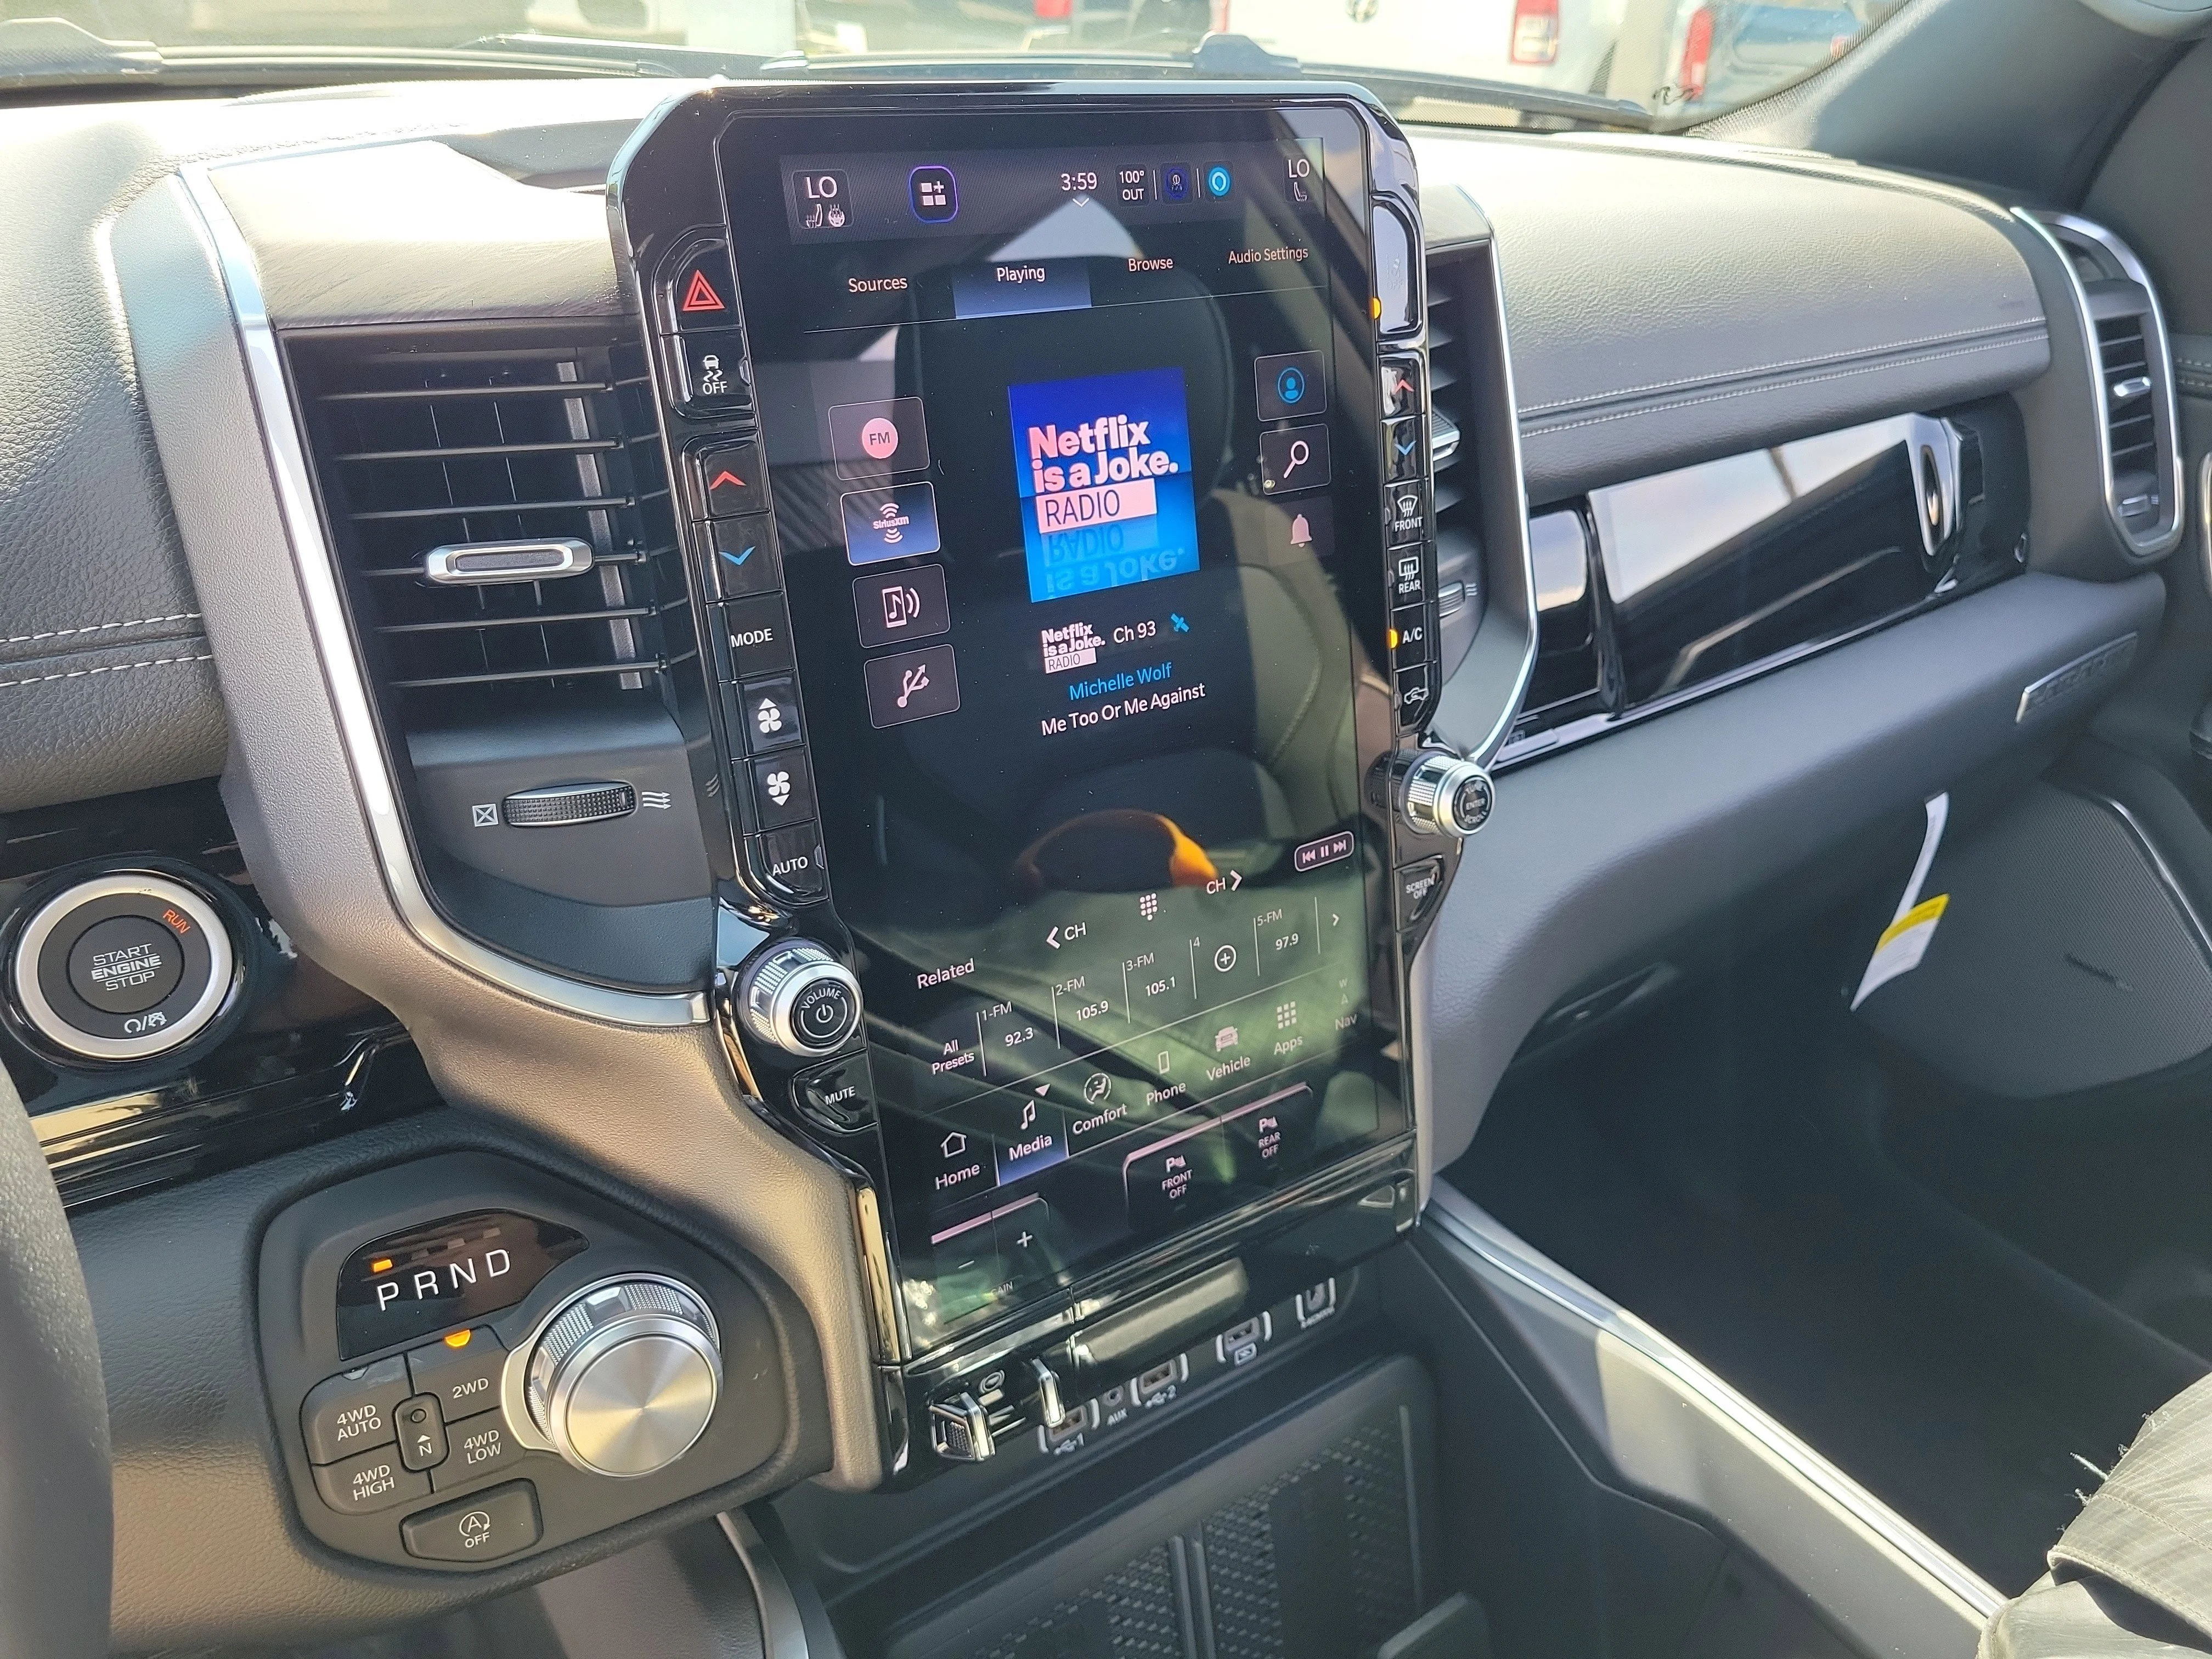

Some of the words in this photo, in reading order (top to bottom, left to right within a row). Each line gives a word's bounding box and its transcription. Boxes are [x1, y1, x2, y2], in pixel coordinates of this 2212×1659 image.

[1288, 159, 1311, 179] LO
[806, 176, 837, 199] LO
[1061, 172, 1097, 191] 3:59
[1122, 188, 1144, 201] OUT
[1128, 258, 1173, 272] Browse
[1228, 250, 1261, 264] Audio
[1264, 246, 1308, 263] Settings
[997, 266, 1045, 282] Playing
[848, 277, 908, 293] Sources
[703, 381, 727, 394] OFF
[870, 432, 890, 445] FM
[1029, 415, 1150, 460] Netflix
[1032, 459, 1065, 493] is
[1069, 462, 1091, 487] a
[1094, 447, 1178, 485] Joke.
[1045, 489, 1120, 527] RADIO
[1395, 516, 1423, 532] FRONT
[1399, 579, 1421, 594] REAR
[731, 628, 774, 647] MODE
[1041, 622, 1093, 644] Netflix
[1114, 625, 1135, 643] Ch
[1137, 620, 1156, 639] 93
[1402, 627, 1423, 644] A/C
[1043, 643, 1057, 657] is
[1058, 643, 1068, 654] a
[1049, 653, 1080, 671] RADIO
[1069, 673, 1135, 701] Michelle
[1137, 662, 1172, 684] Wolf
[1042, 718, 1067, 736] Me
[1069, 712, 1098, 730] Too
[1102, 704, 1122, 721] Or
[1124, 698, 1148, 715] Me
[1150, 682, 1206, 710] Against
[772, 856, 809, 877] AUTO
[1206, 877, 1226, 895] CH
[1406, 877, 1434, 894] SCREEN
[163, 909, 191, 933] RUN
[1257, 909, 1283, 927] 5-FM
[1064, 922, 1087, 941] CH
[1193, 936, 1200, 948] 4
[1276, 933, 1299, 951] 97.9
[93, 944, 152, 966] START
[1126, 952, 1155, 972] 3-FM
[92, 955, 161, 980] ENGINE
[917, 958, 975, 989] Related
[105, 970, 155, 991] STOP
[1056, 976, 1086, 996] 2-FM
[1146, 976, 1176, 997] 105.1
[802, 988, 842, 1010] VOLUME
[982, 1001, 1012, 1021] 1-FM
[1076, 1000, 1109, 1022] 105.9
[1335, 1013, 1357, 1031] Nav
[1005, 1027, 1034, 1047] 92.3
[1274, 1035, 1303, 1055] Apps
[943, 1039, 958, 1056] All
[932, 1051, 975, 1075] Presets
[1206, 1056, 1251, 1081] Vehicle
[825, 1086, 856, 1105] MUTE
[1147, 1082, 1187, 1106] Phone
[1073, 1103, 1128, 1134] Comfort
[1009, 1135, 1053, 1161] Media
[1258, 1131, 1281, 1149] REAR
[1262, 1144, 1279, 1159] OFF
[935, 1164, 980, 1190] Home
[1162, 1169, 1193, 1191] FRONT
[1170, 1184, 1187, 1199] OFF
[377, 1282, 399, 1311] P
[414, 1270, 439, 1300] R
[449, 1258, 477, 1289] N
[486, 1249, 510, 1277] D
[453, 1378, 489, 1398] 2WD
[337, 1404, 376, 1425] 4WD
[1107, 1408, 1127, 1425] AUX
[337, 1417, 381, 1441] AUTO
[419, 1442, 432, 1457] N
[464, 1430, 499, 1449] 4WD
[466, 1442, 501, 1464] LOW
[353, 1464, 391, 1485] 4WD
[353, 1476, 395, 1500] HIGH
[465, 1532, 490, 1548] OFF
